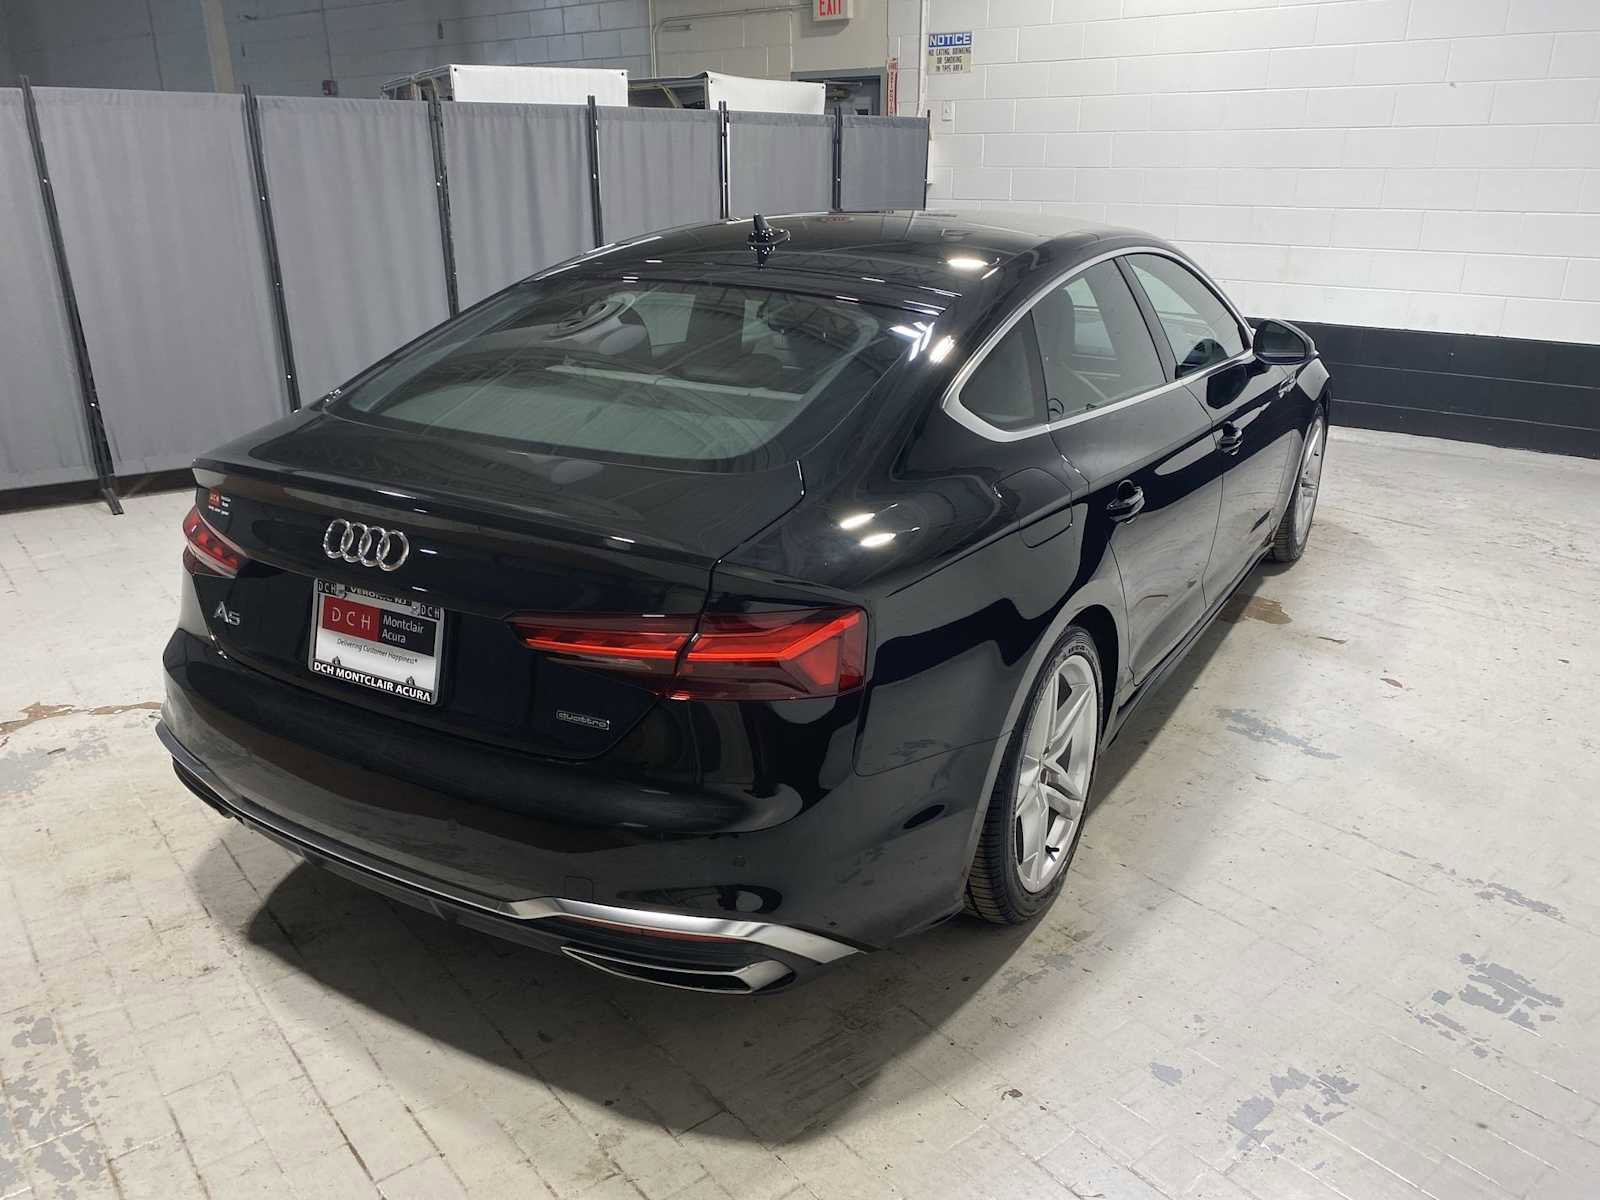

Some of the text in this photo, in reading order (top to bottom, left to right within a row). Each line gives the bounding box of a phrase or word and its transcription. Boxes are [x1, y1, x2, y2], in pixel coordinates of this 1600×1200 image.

[929, 33, 971, 46] NOTICE
[944, 55, 962, 64] SMOKING
[318, 581, 337, 594] DCH
[213, 600, 240, 626] A5
[420, 604, 440, 619] DCH
[382, 615, 424, 634] Montclair
[381, 629, 406, 644] Acura
[336, 638, 362, 652] Delivering
[363, 644, 388, 657] Customer
[313, 661, 431, 702] DCH MONTCLAIR ACURA
[558, 711, 608, 729] quattro
